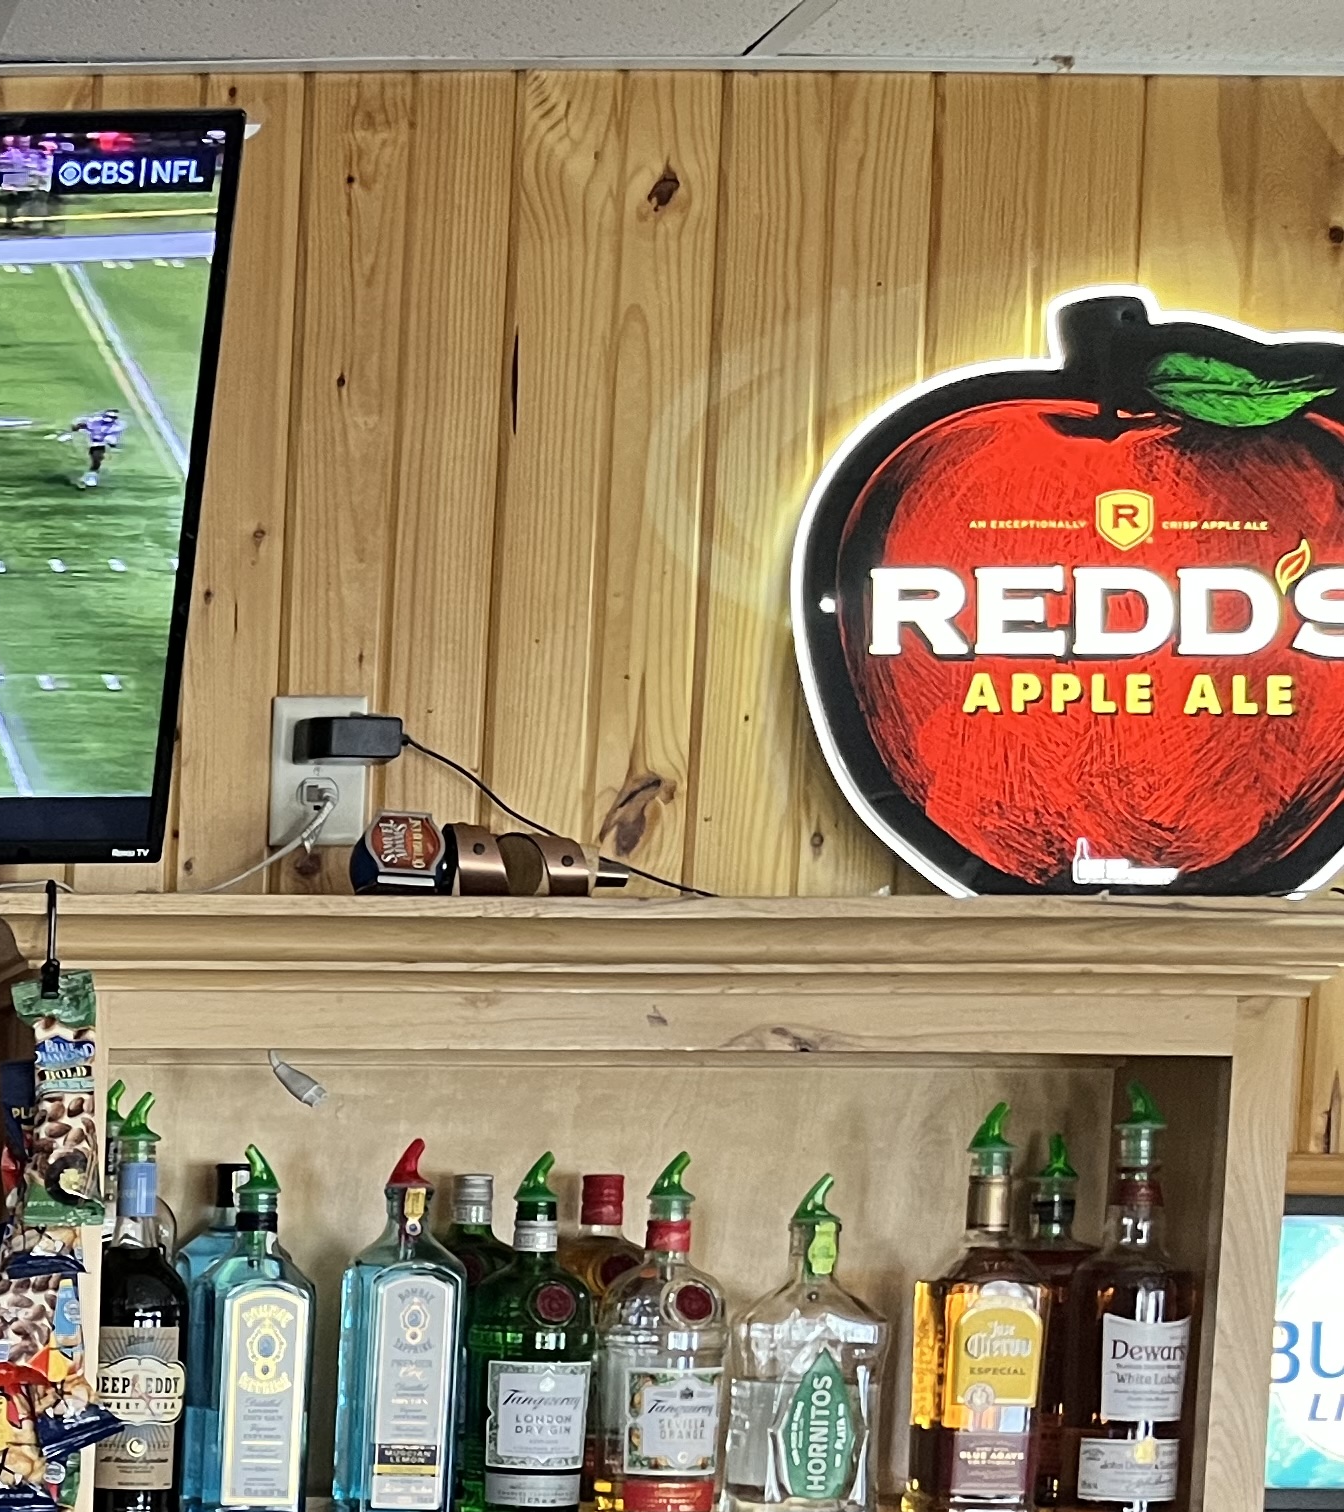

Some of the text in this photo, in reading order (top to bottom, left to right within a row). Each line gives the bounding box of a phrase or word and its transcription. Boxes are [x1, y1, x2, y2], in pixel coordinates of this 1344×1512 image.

[85, 159, 204, 185] CBS NFL
[1201, 521, 1240, 530] APPLE
[1244, 521, 1268, 530] ALE
[963, 672, 1295, 716] APPLE ALE
[45, 1040, 76, 1053] BLUE
[35, 1043, 94, 1064] DIAMOND
[45, 1066, 87, 1079] BOLD
[1115, 1371, 1152, 1384] White
[145, 1376, 182, 1394] EDDY
[515, 1414, 572, 1423] LONDON
[515, 1426, 571, 1435] DRY GIN
[805, 1375, 834, 1493] HORNITOS
